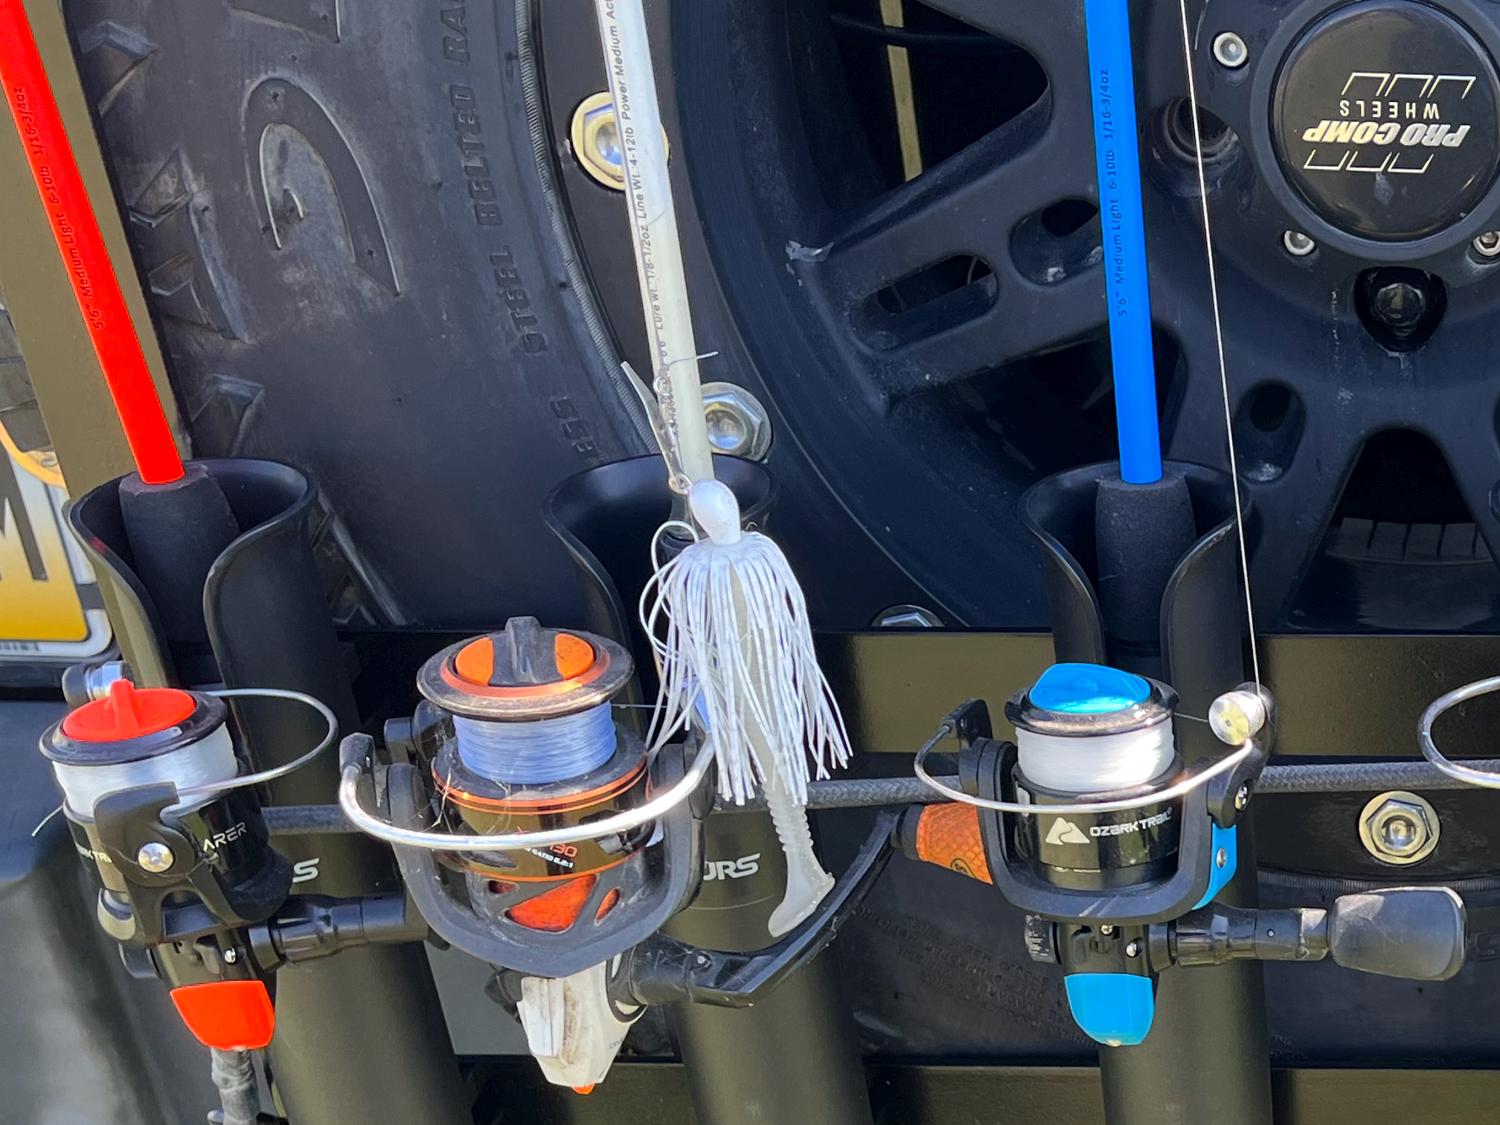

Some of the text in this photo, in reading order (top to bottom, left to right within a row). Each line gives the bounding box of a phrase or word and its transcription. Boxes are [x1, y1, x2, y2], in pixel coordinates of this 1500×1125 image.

[610, 25, 626, 76] Medium
[1100, 69, 1115, 141] 1/16-3/4oz
[1339, 99, 1440, 120] WHEELS
[1302, 119, 1471, 148] PRO COMP
[1104, 149, 1117, 191] 6-10lb
[634, 193, 649, 221] Line
[1107, 199, 1123, 231] Light
[55, 213, 75, 245] Light
[70, 246, 94, 298] Medium
[1112, 233, 1126, 285] Medium
[202, 821, 248, 853] ARER
[1089, 821, 1140, 838] OZARK
